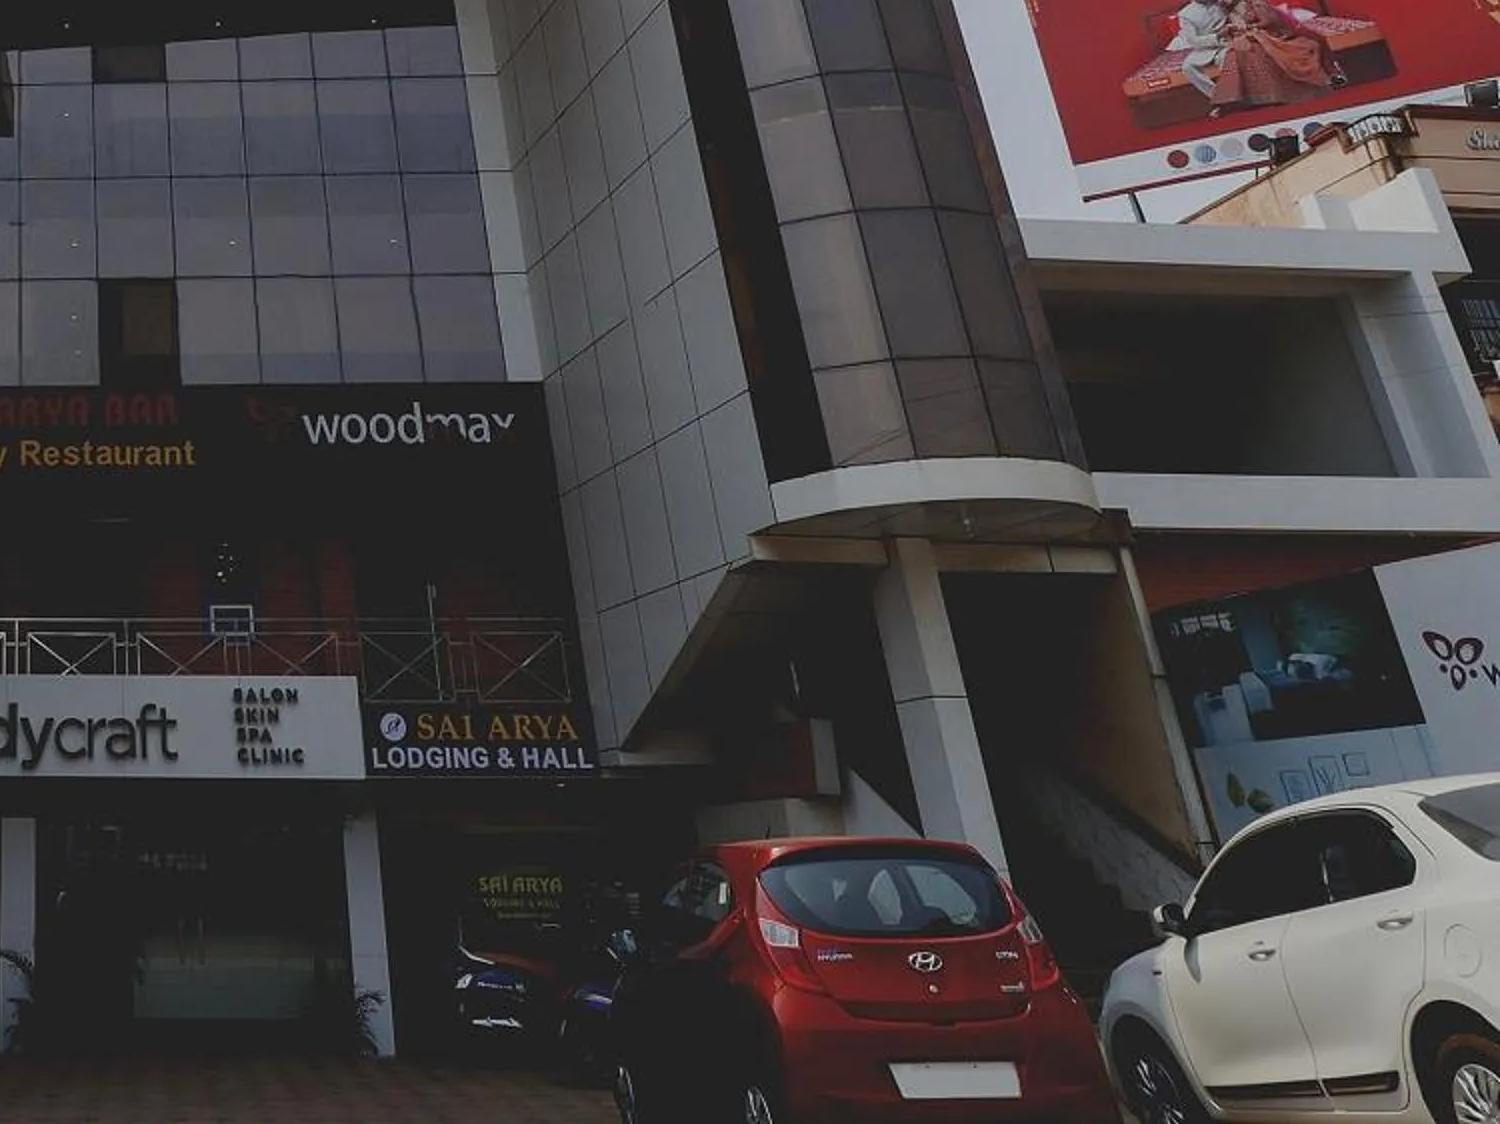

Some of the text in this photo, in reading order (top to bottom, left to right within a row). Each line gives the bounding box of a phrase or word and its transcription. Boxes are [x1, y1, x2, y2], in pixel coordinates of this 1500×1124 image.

[19, 438, 198, 467] Restaurant
[233, 687, 299, 703] SALON
[234, 707, 280, 723] SKIN
[237, 727, 273, 743] SPA
[416, 712, 476, 741] SAI
[487, 713, 581, 741] ARYA
[237, 747, 305, 765] CLINIC
[371, 745, 594, 770] LODGING & HALL
